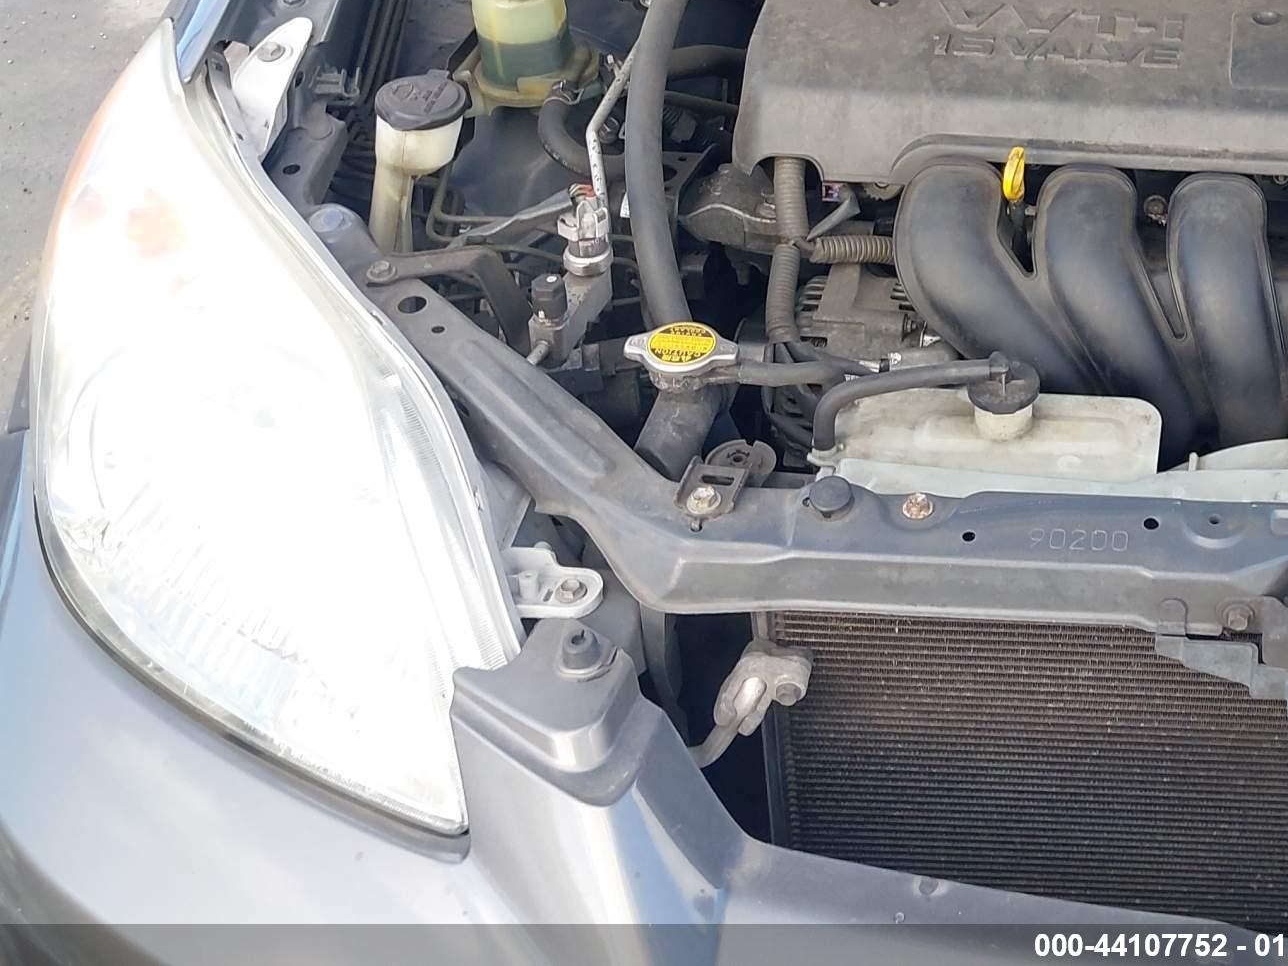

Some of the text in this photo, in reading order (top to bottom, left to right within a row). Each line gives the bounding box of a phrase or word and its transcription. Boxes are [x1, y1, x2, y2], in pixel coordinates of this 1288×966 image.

[1005, 34, 1182, 68] VALVE
[655, 347, 701, 357] CAUTION
[1029, 528, 1129, 552] 90200
